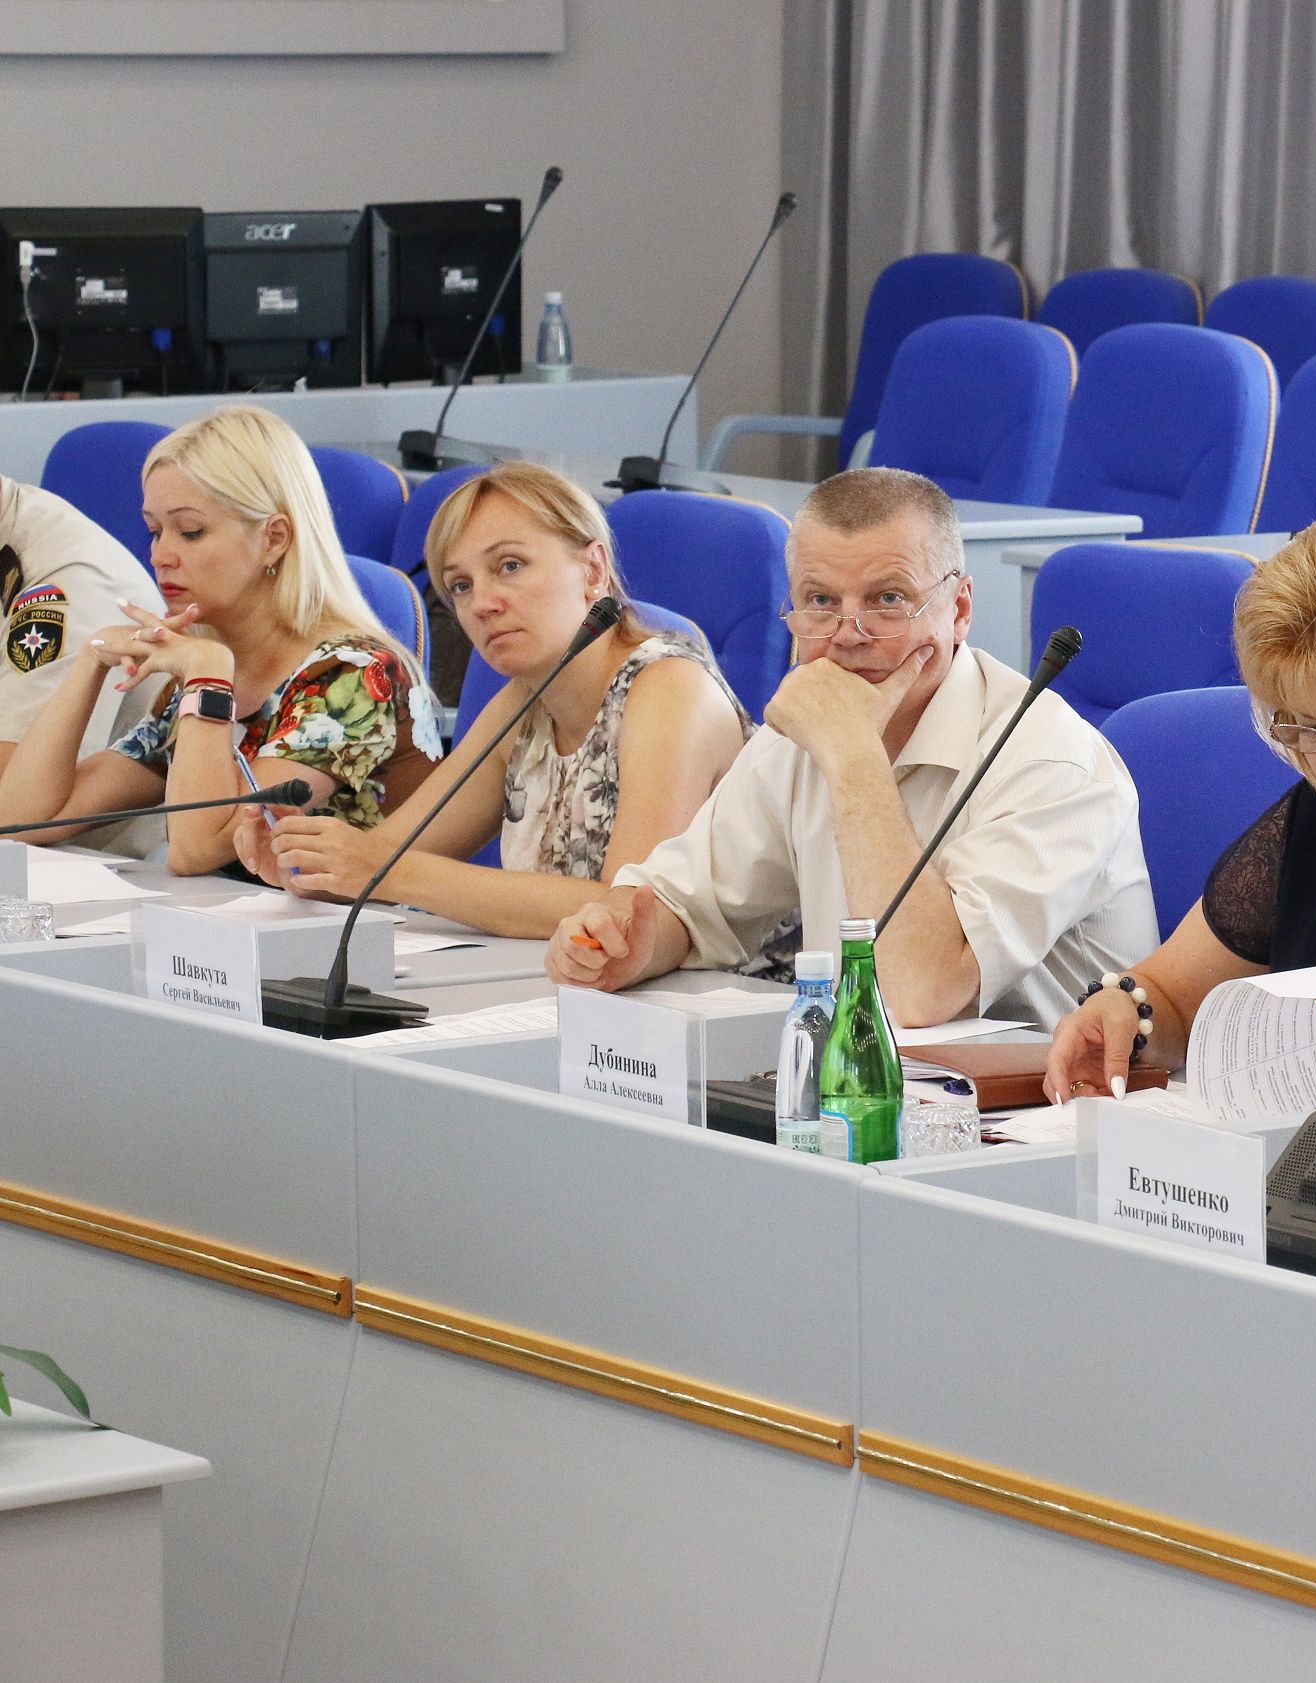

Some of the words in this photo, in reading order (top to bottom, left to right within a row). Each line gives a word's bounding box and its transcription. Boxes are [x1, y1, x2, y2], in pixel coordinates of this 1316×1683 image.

[245, 223, 297, 240] acer
[18, 593, 57, 610] RUSSIA
[31, 610, 62, 621] РОССИИ
[172, 955, 228, 988] Шавкута
[162, 982, 191, 1002] Сергей
[193, 988, 241, 1012] Васильевич
[588, 1043, 657, 1079] Дубинина
[583, 1075, 608, 1093] Алла
[610, 1081, 664, 1106] Алексеевна
[1128, 1166, 1229, 1214] Евтушенко
[1113, 1199, 1168, 1227] Дмитрий
[1171, 1212, 1245, 1247] Викторович
